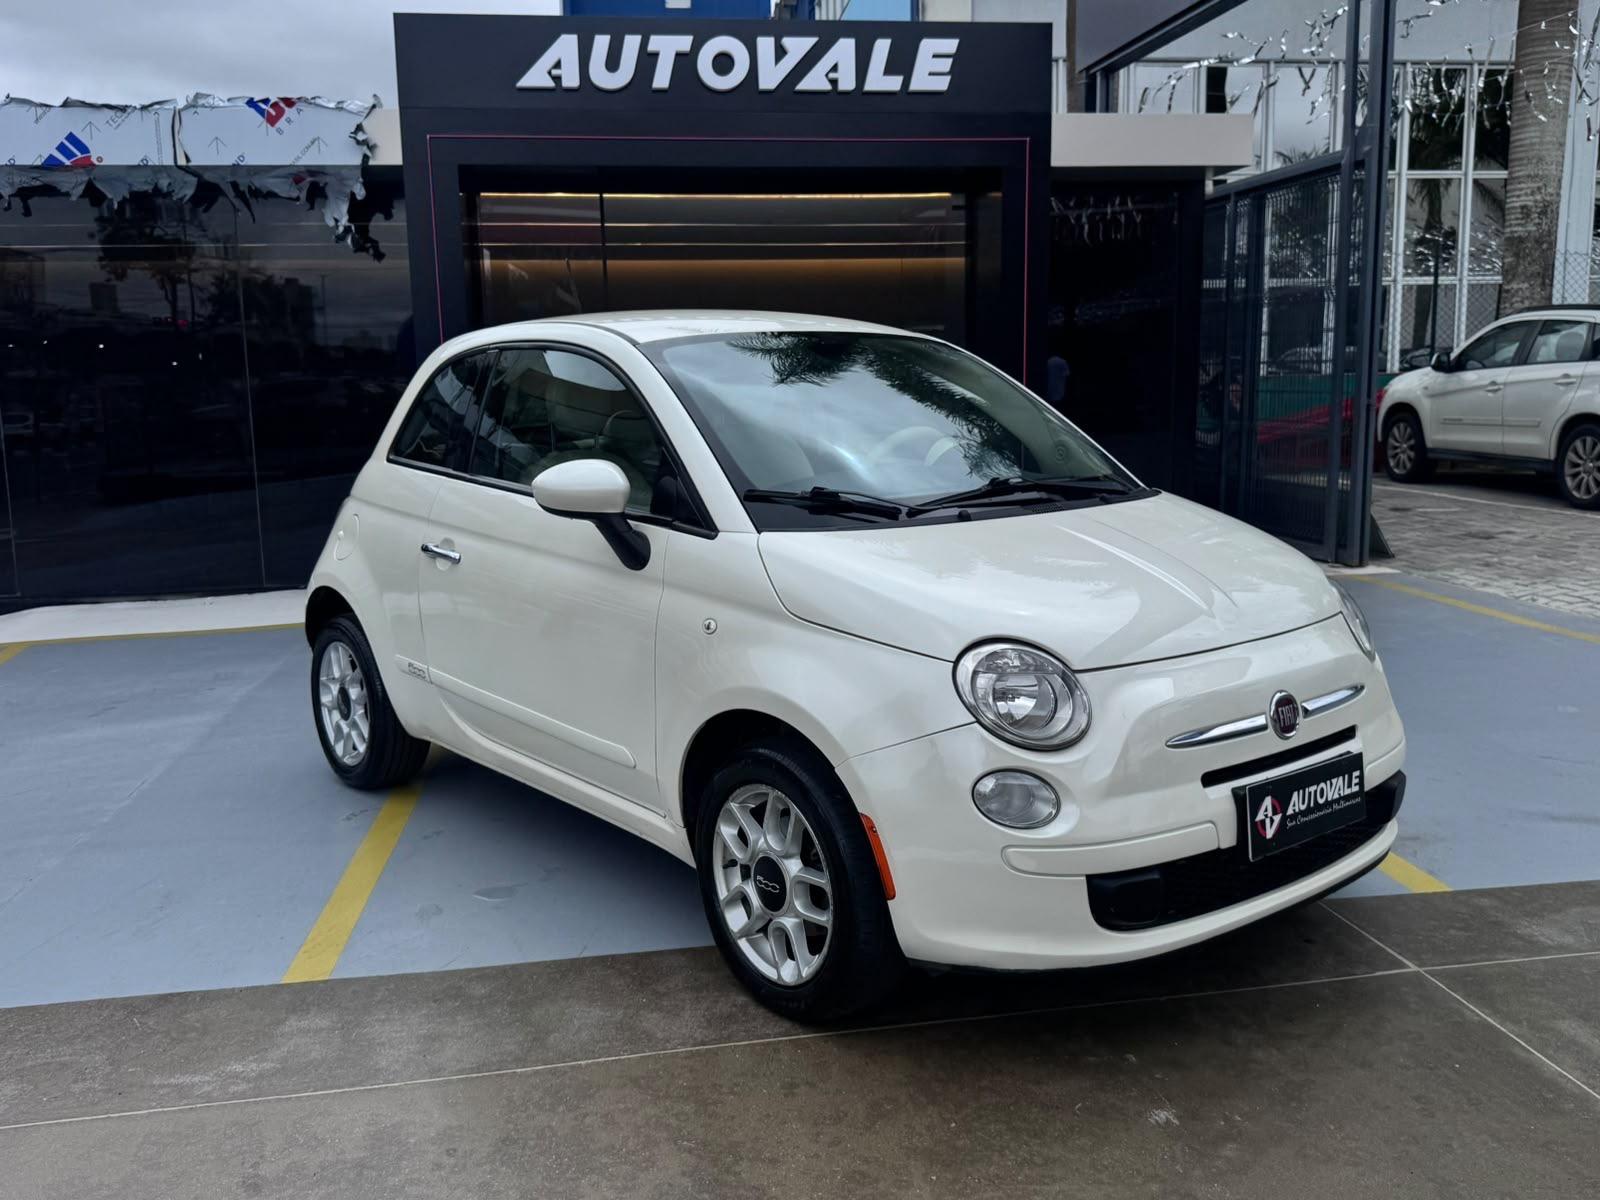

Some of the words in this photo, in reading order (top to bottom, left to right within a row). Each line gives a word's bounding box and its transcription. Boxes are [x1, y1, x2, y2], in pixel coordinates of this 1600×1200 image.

[515, 33, 960, 93] AUTOVALE
[1277, 702, 1297, 728] FIAT
[1286, 769, 1361, 816] AUTOVALE
[756, 875, 780, 893] 500
